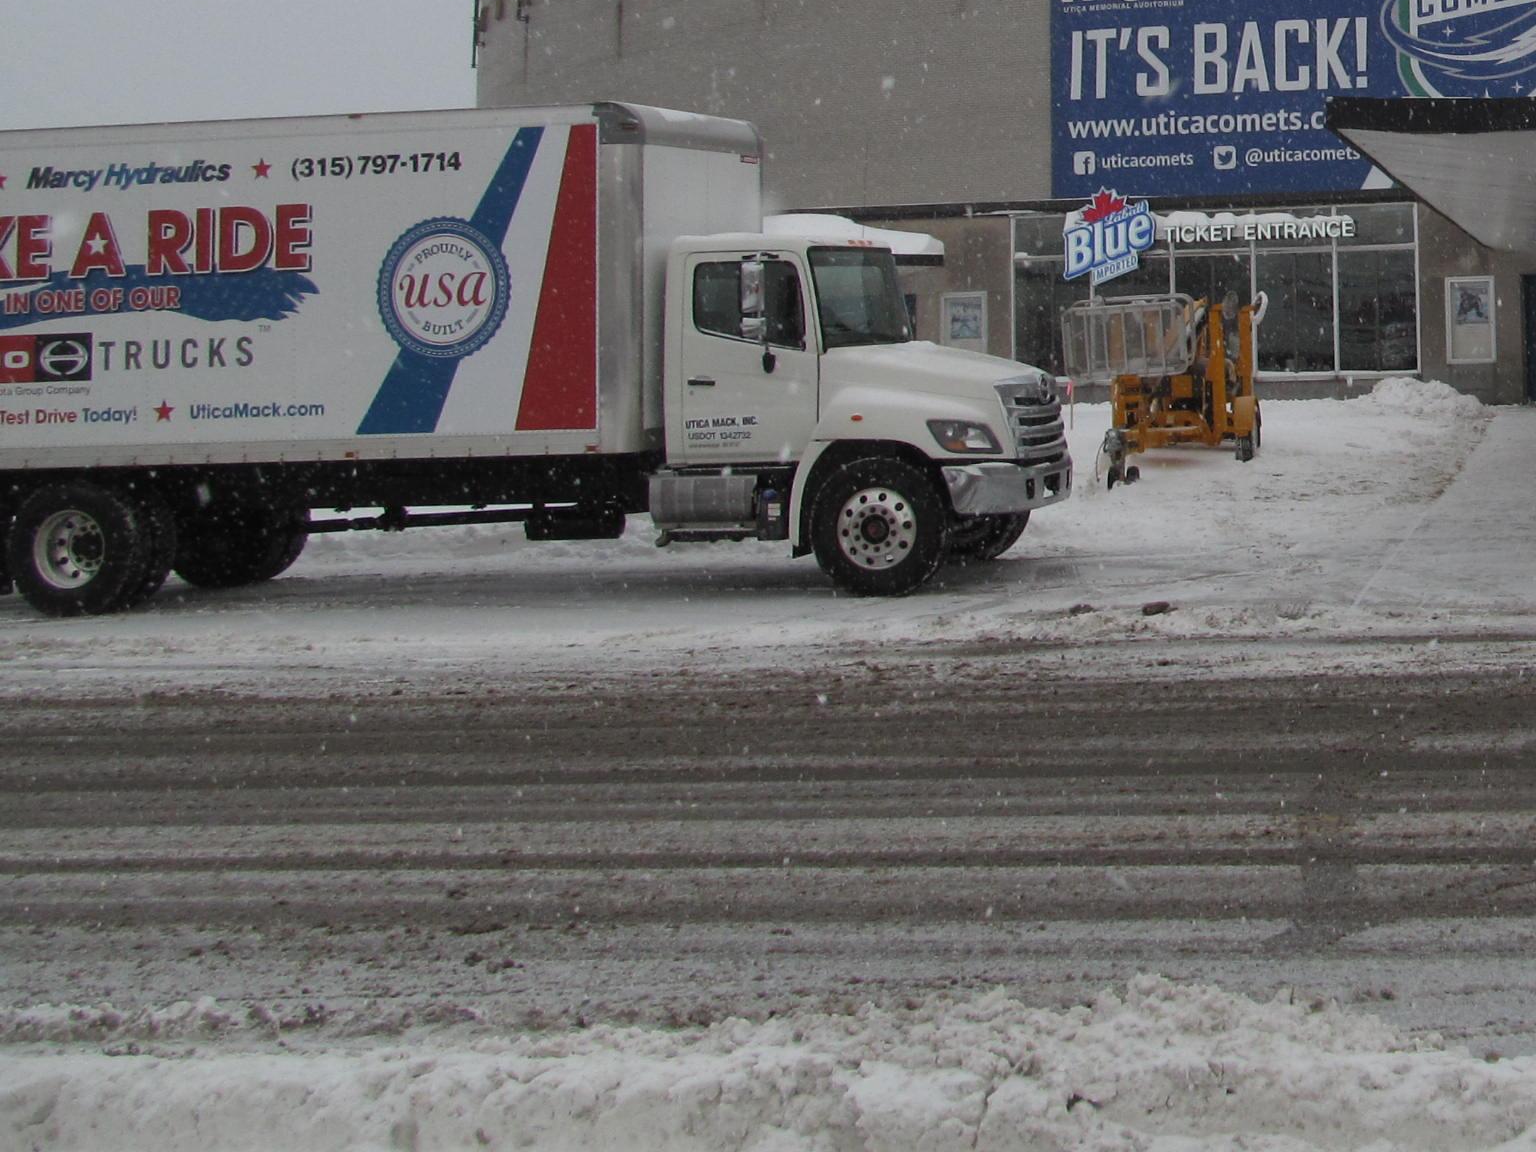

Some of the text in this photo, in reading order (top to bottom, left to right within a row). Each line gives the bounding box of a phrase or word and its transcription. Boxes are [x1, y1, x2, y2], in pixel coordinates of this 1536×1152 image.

[1063, 0, 1185, 14] UTICA MEMORIAL AUDITORIUM
[1070, 16, 1368, 100] IT'S BACK!
[1068, 108, 1326, 139] www.uticacomets.c
[291, 151, 463, 181] (315) 797-1714
[1101, 151, 1194, 169] uticacomets
[1245, 146, 1361, 167] @uticacomets
[27, 159, 231, 192] Marcy Hydraulics
[69, 211, 127, 279] A
[146, 203, 313, 276] RIDE
[1164, 219, 1355, 243] TICKET ENTRANCE
[414, 242, 474, 264] PROUDLY
[1066, 212, 1154, 275] Blue
[1092, 255, 1138, 281] IMPORTED
[4, 285, 181, 315] IN ONE OF OUR
[421, 319, 465, 335] BUILT
[98, 335, 255, 371] TRUCKS
[15, 386, 43, 397] Group
[46, 384, 91, 396] Company
[0, 406, 137, 425] Test Drive Today!
[189, 402, 325, 419] UticaMack.com
[685, 419, 710, 429] UTICA
[742, 415, 759, 425] INC.
[687, 431, 716, 440] USDOT
